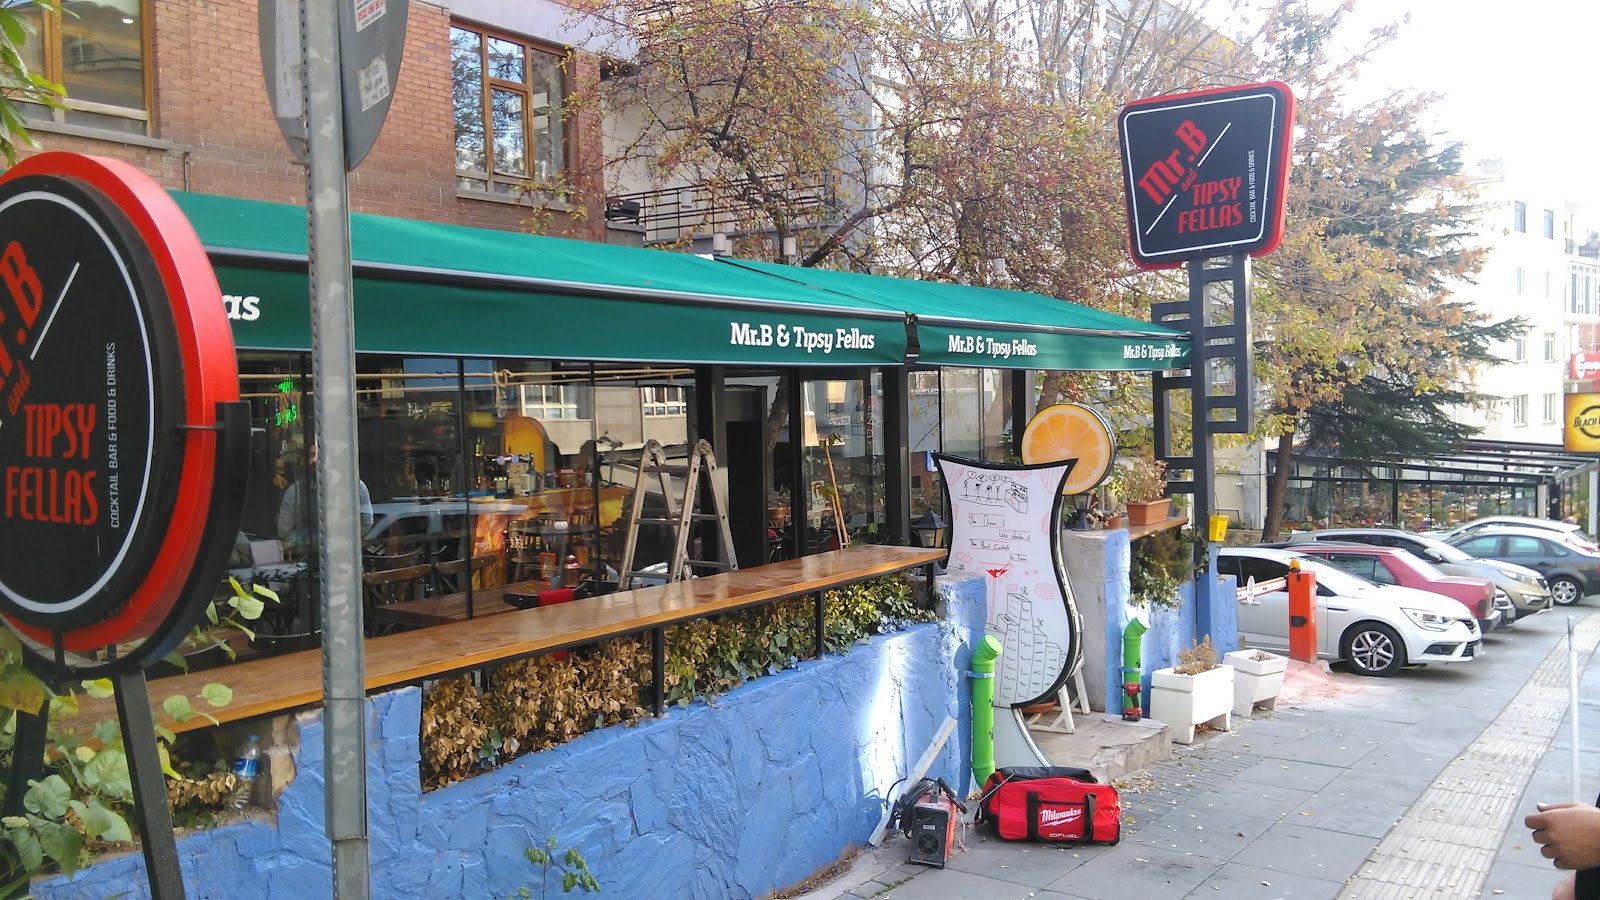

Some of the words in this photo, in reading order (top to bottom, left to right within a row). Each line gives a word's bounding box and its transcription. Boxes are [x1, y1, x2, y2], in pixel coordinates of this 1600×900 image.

[1138, 120, 1207, 205] Mr.B
[1181, 167, 1198, 192] and
[1192, 176, 1242, 207] TIPSY
[1177, 202, 1243, 234] FELLAS
[1249, 201, 1257, 223] COCKTAIL
[730, 322, 773, 347] Mr.B
[776, 324, 790, 347] &
[835, 328, 875, 350] Fellas
[948, 334, 974, 353] Mr.B
[975, 335, 984, 354] &
[1012, 338, 1038, 356] Fellas
[106, 342, 117, 386] DRINKS
[1123, 344, 1140, 359] Mr.B
[1141, 344, 1147, 359] &
[1164, 343, 1181, 358] Fellas
[8, 360, 30, 416] and
[107, 388, 117, 396] &
[107, 399, 117, 430] FOOD
[23, 403, 96, 460] TIPSY
[108, 433, 118, 441] &
[108, 443, 118, 468] BAR
[5, 466, 99, 526] FELLAS
[109, 472, 120, 528] COCKTAIL
[1039, 807, 1082, 823] Milwaukee
